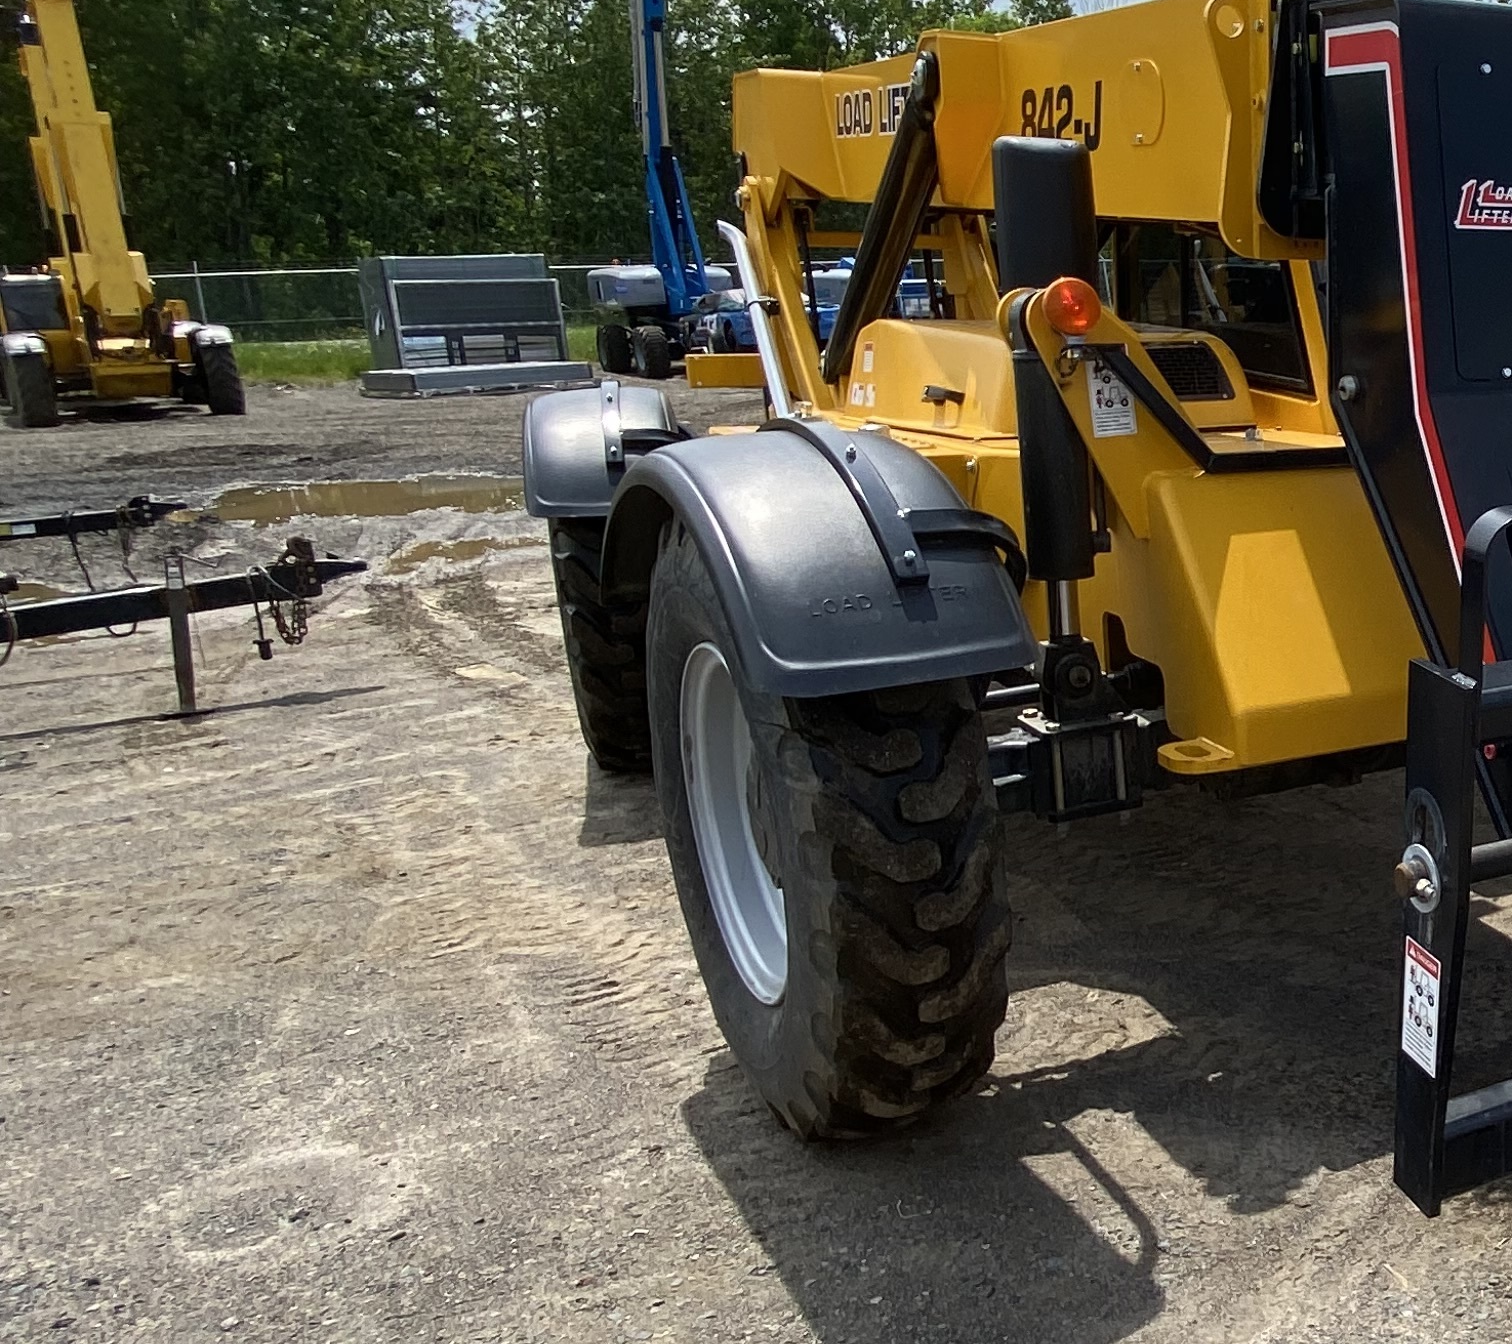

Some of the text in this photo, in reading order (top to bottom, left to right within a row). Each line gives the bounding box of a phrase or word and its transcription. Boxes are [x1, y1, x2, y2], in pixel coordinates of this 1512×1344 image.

[835, 88, 872, 138] LOAD
[1021, 80, 1103, 152] 842-J
[806, 593, 873, 617] LOAD
